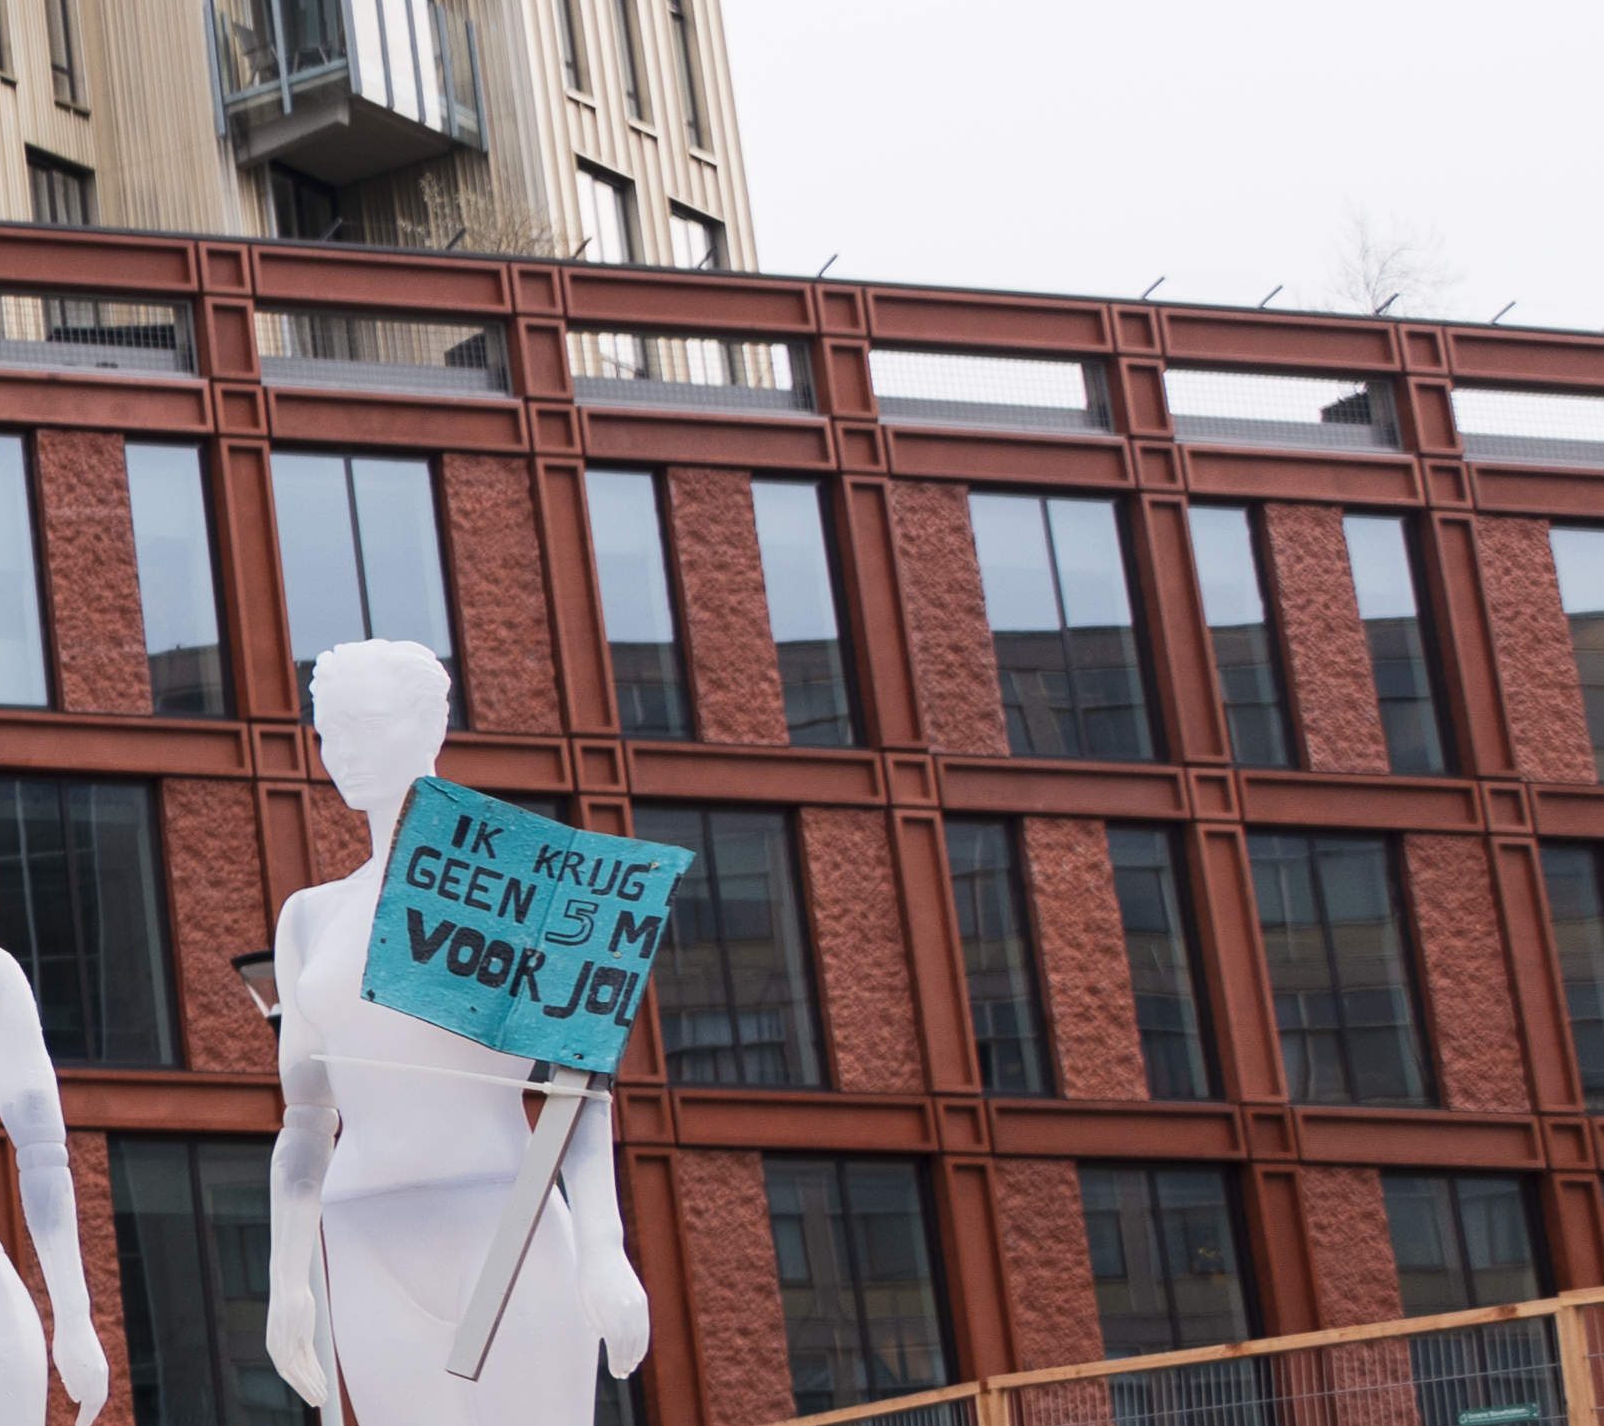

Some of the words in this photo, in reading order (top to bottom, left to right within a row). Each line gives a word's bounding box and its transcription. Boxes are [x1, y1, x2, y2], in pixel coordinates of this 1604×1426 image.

[406, 846, 536, 924] GEEN
[545, 899, 598, 946] 5
[451, 815, 504, 859] IK
[533, 844, 652, 902] KRIJG
[406, 907, 545, 1002] VOOR
